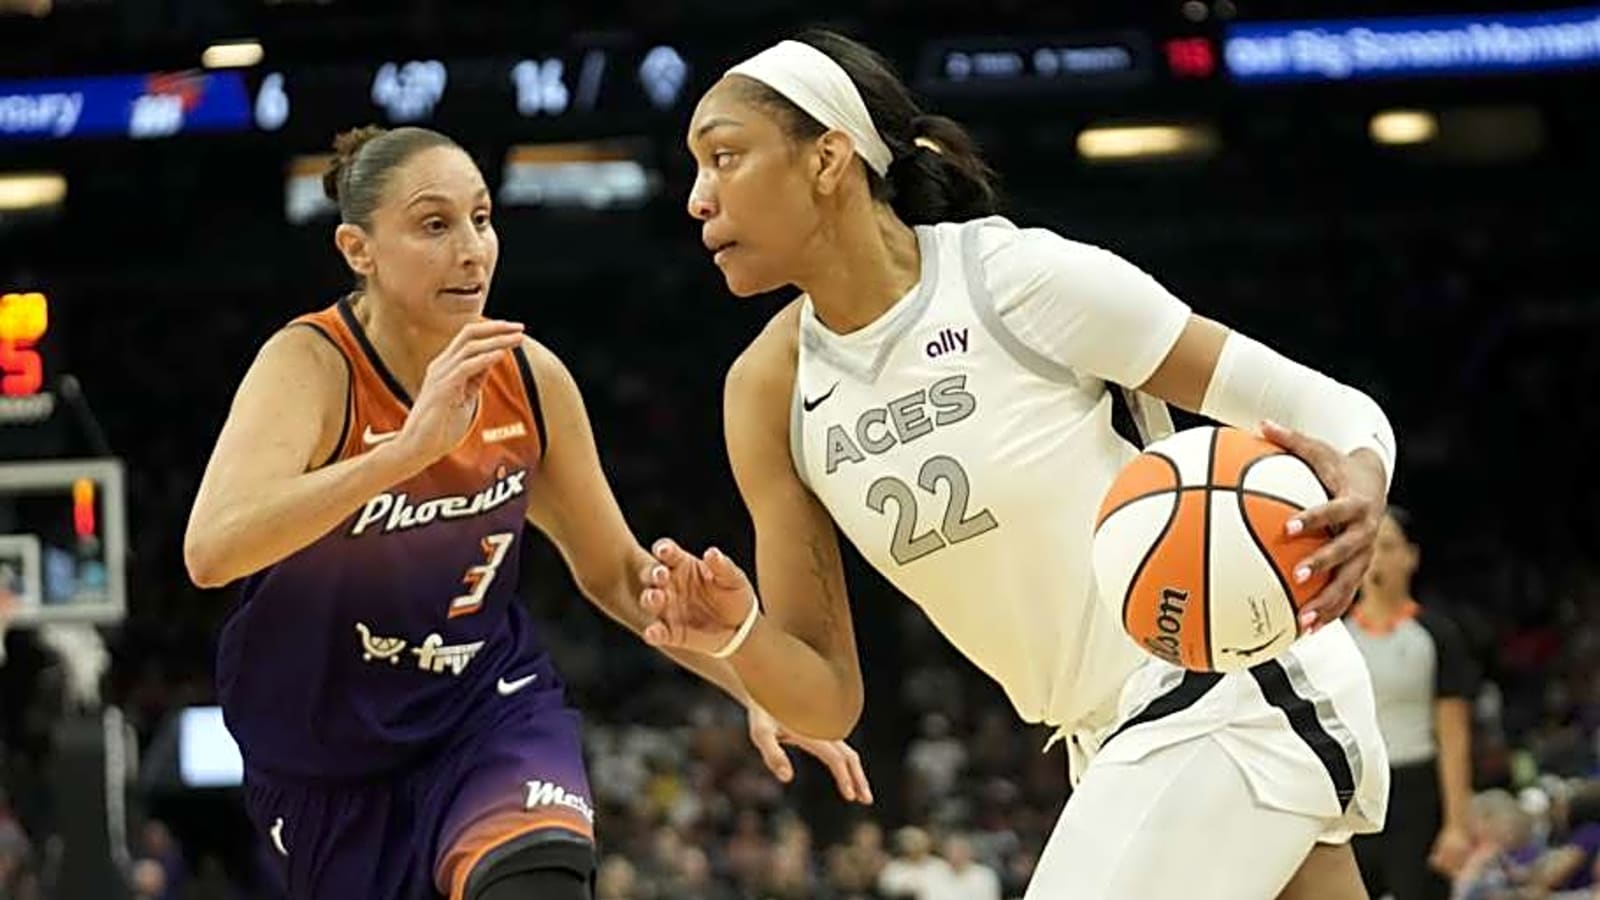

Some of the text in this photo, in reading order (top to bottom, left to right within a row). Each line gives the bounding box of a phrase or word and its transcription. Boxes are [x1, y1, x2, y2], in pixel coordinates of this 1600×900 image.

[926, 328, 969, 357] ally
[826, 374, 976, 474] ACES
[350, 464, 527, 536] Phoenix
[865, 455, 998, 566] 22
[447, 532, 514, 618] 3
